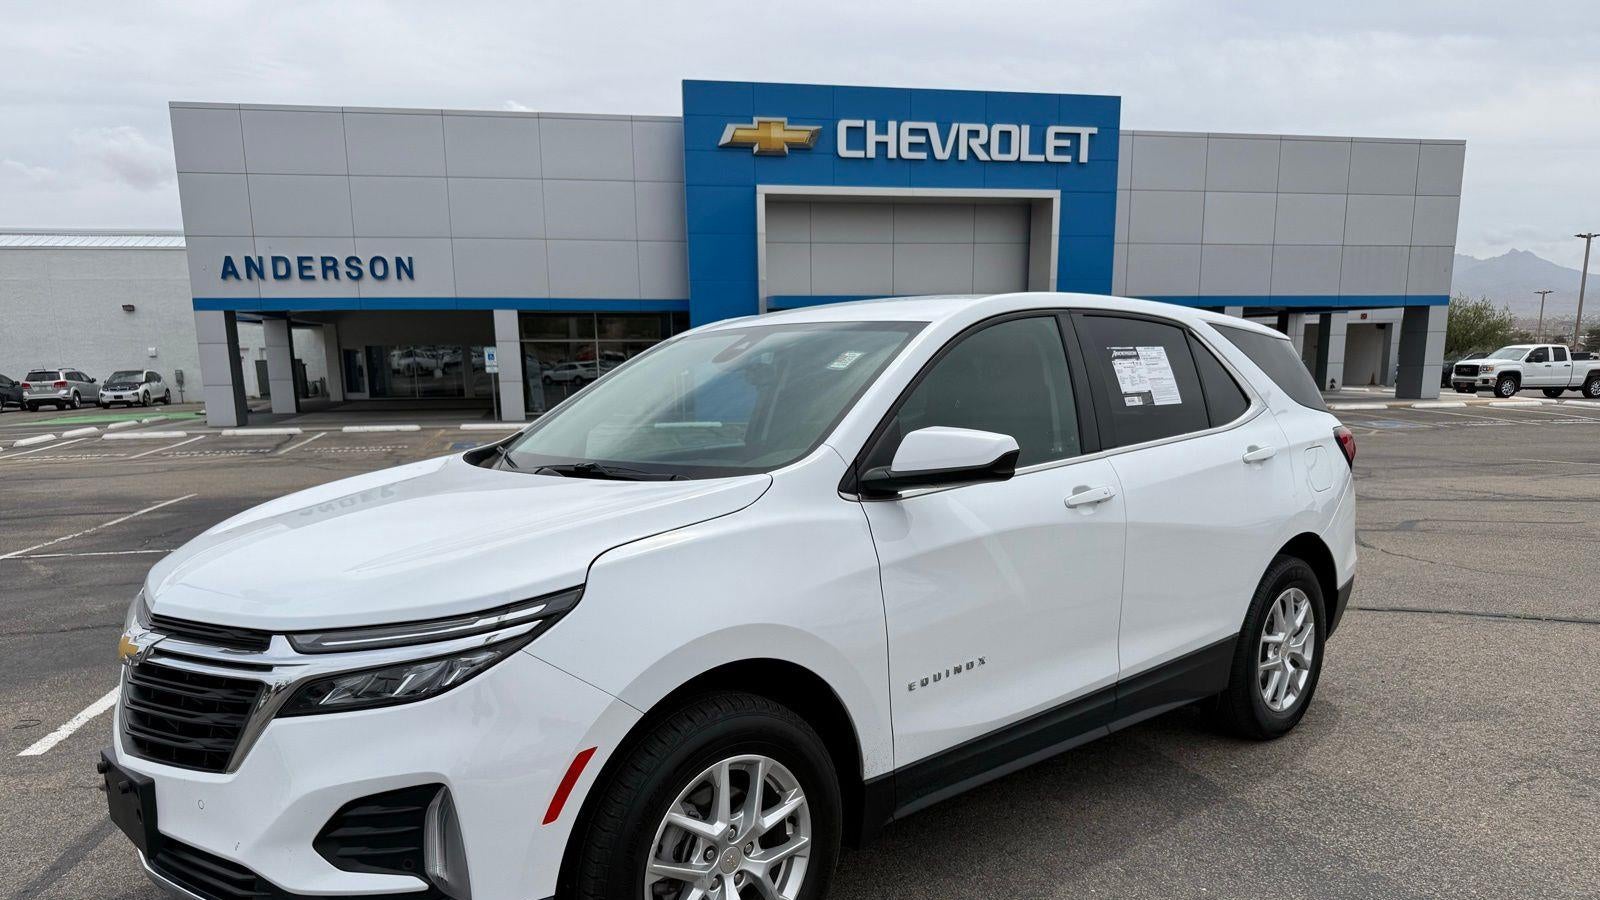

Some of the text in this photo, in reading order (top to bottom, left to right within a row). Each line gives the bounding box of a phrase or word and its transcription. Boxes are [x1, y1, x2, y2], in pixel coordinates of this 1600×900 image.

[837, 119, 1098, 163] CHEVROLET
[221, 256, 414, 280] ANDERSON
[907, 656, 986, 692] EQUINOX
